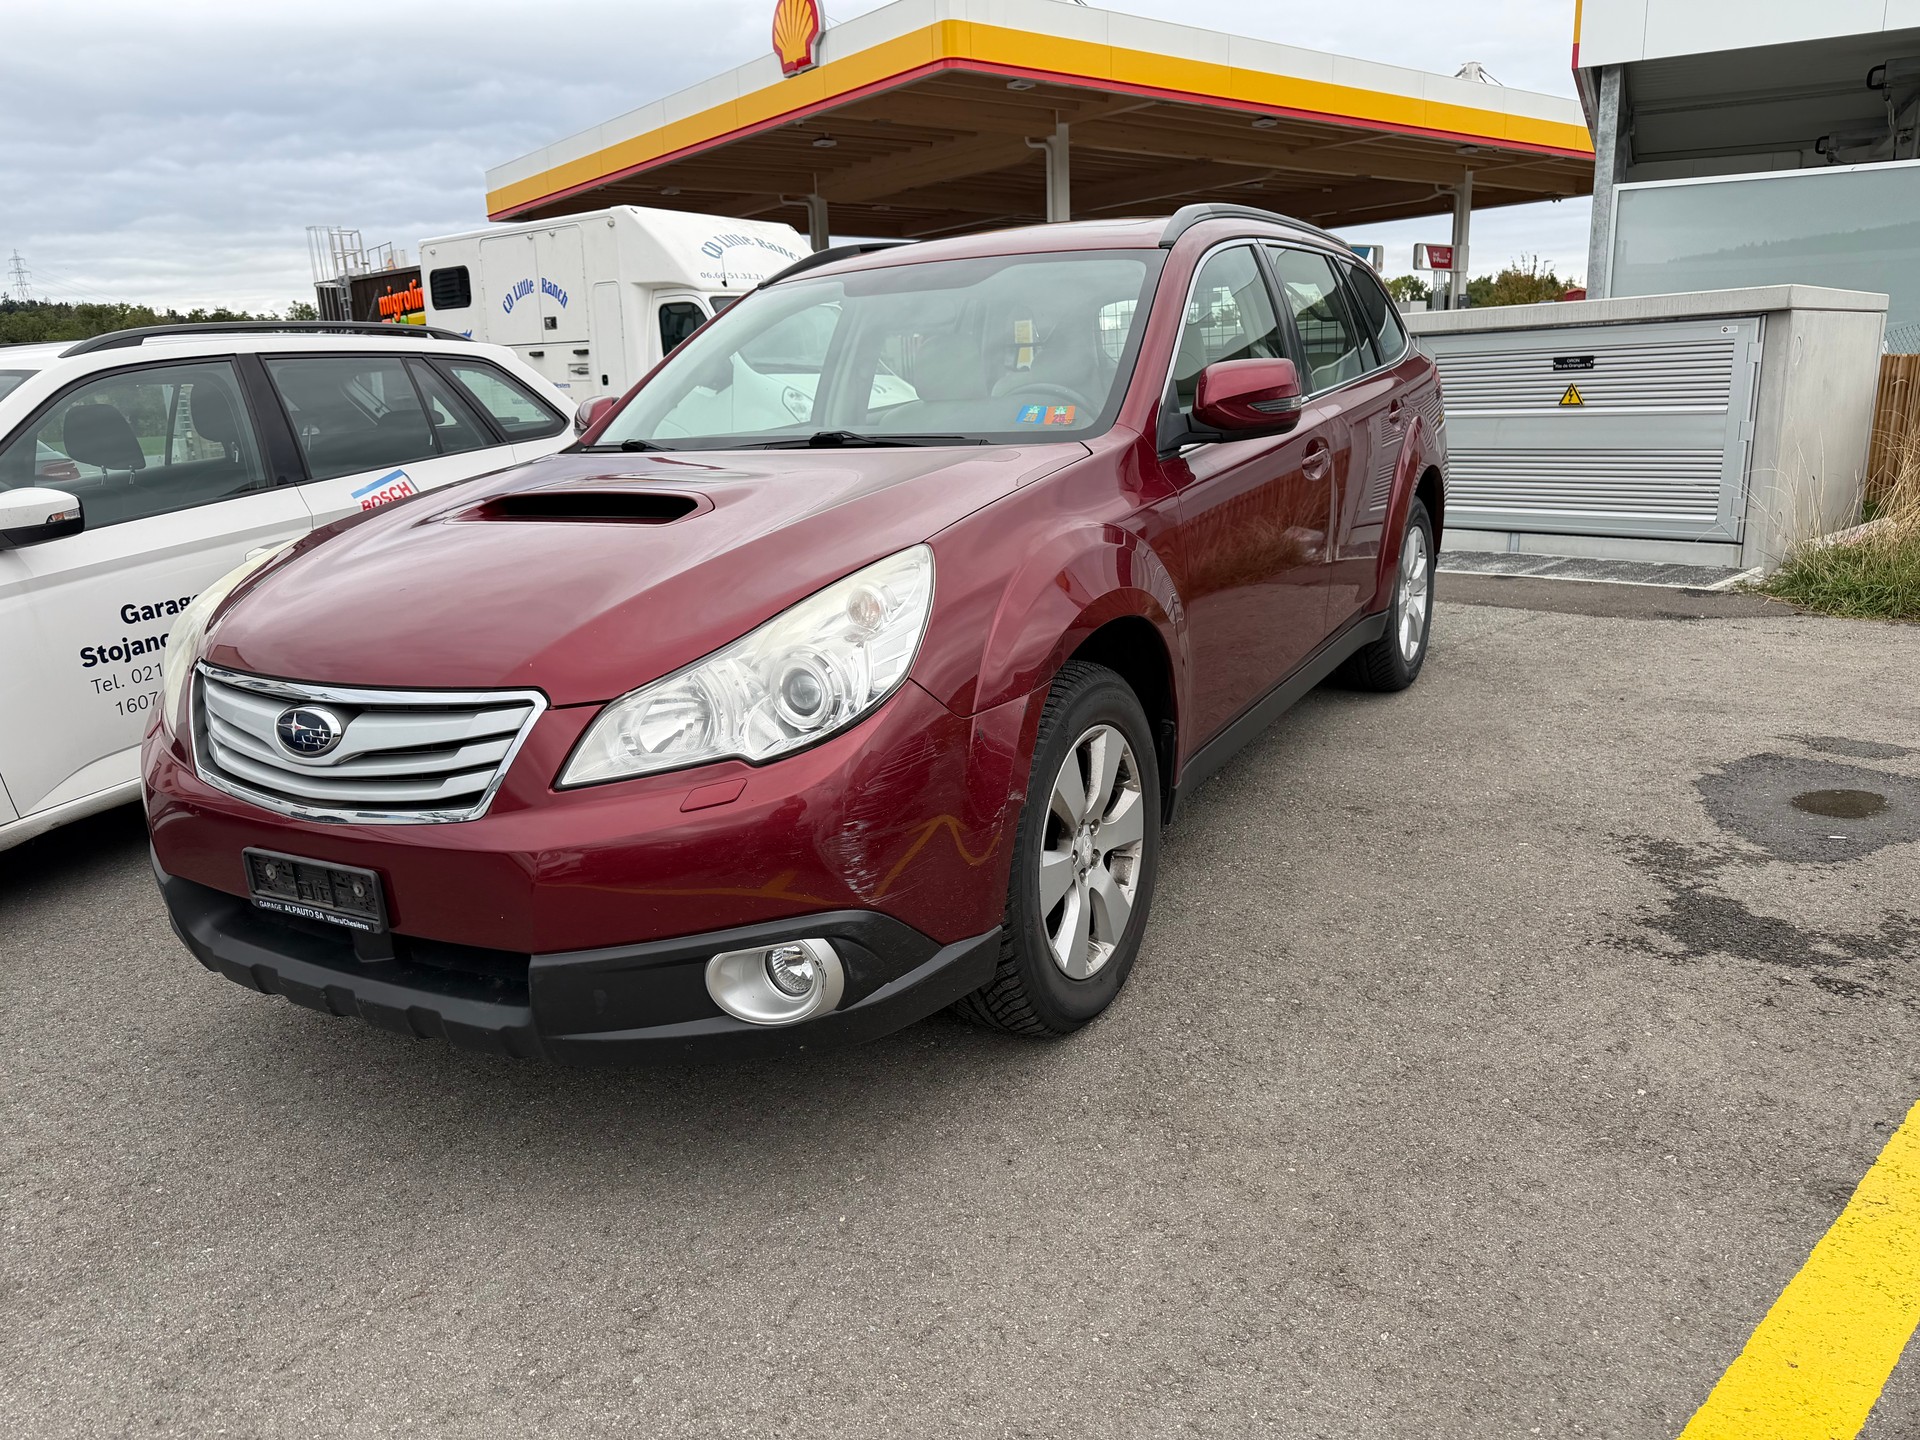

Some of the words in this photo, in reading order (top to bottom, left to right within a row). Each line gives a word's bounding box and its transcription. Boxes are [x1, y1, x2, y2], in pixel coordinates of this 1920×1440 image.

[701, 241, 723, 259] CD
[713, 233, 755, 248] Little
[754, 237, 802, 262] Ranc
[502, 293, 514, 314] CD
[512, 278, 535, 301] Little
[541, 277, 568, 309] Ranch
[361, 481, 413, 511] BOSCH
[120, 594, 199, 625] Garag
[91, 674, 125, 694] Tel.
[131, 663, 163, 684] 021
[115, 691, 158, 716] 1607
[259, 900, 282, 911] GARAGE
[284, 904, 314, 918] ALPAUTO
[314, 911, 325, 920] SA
